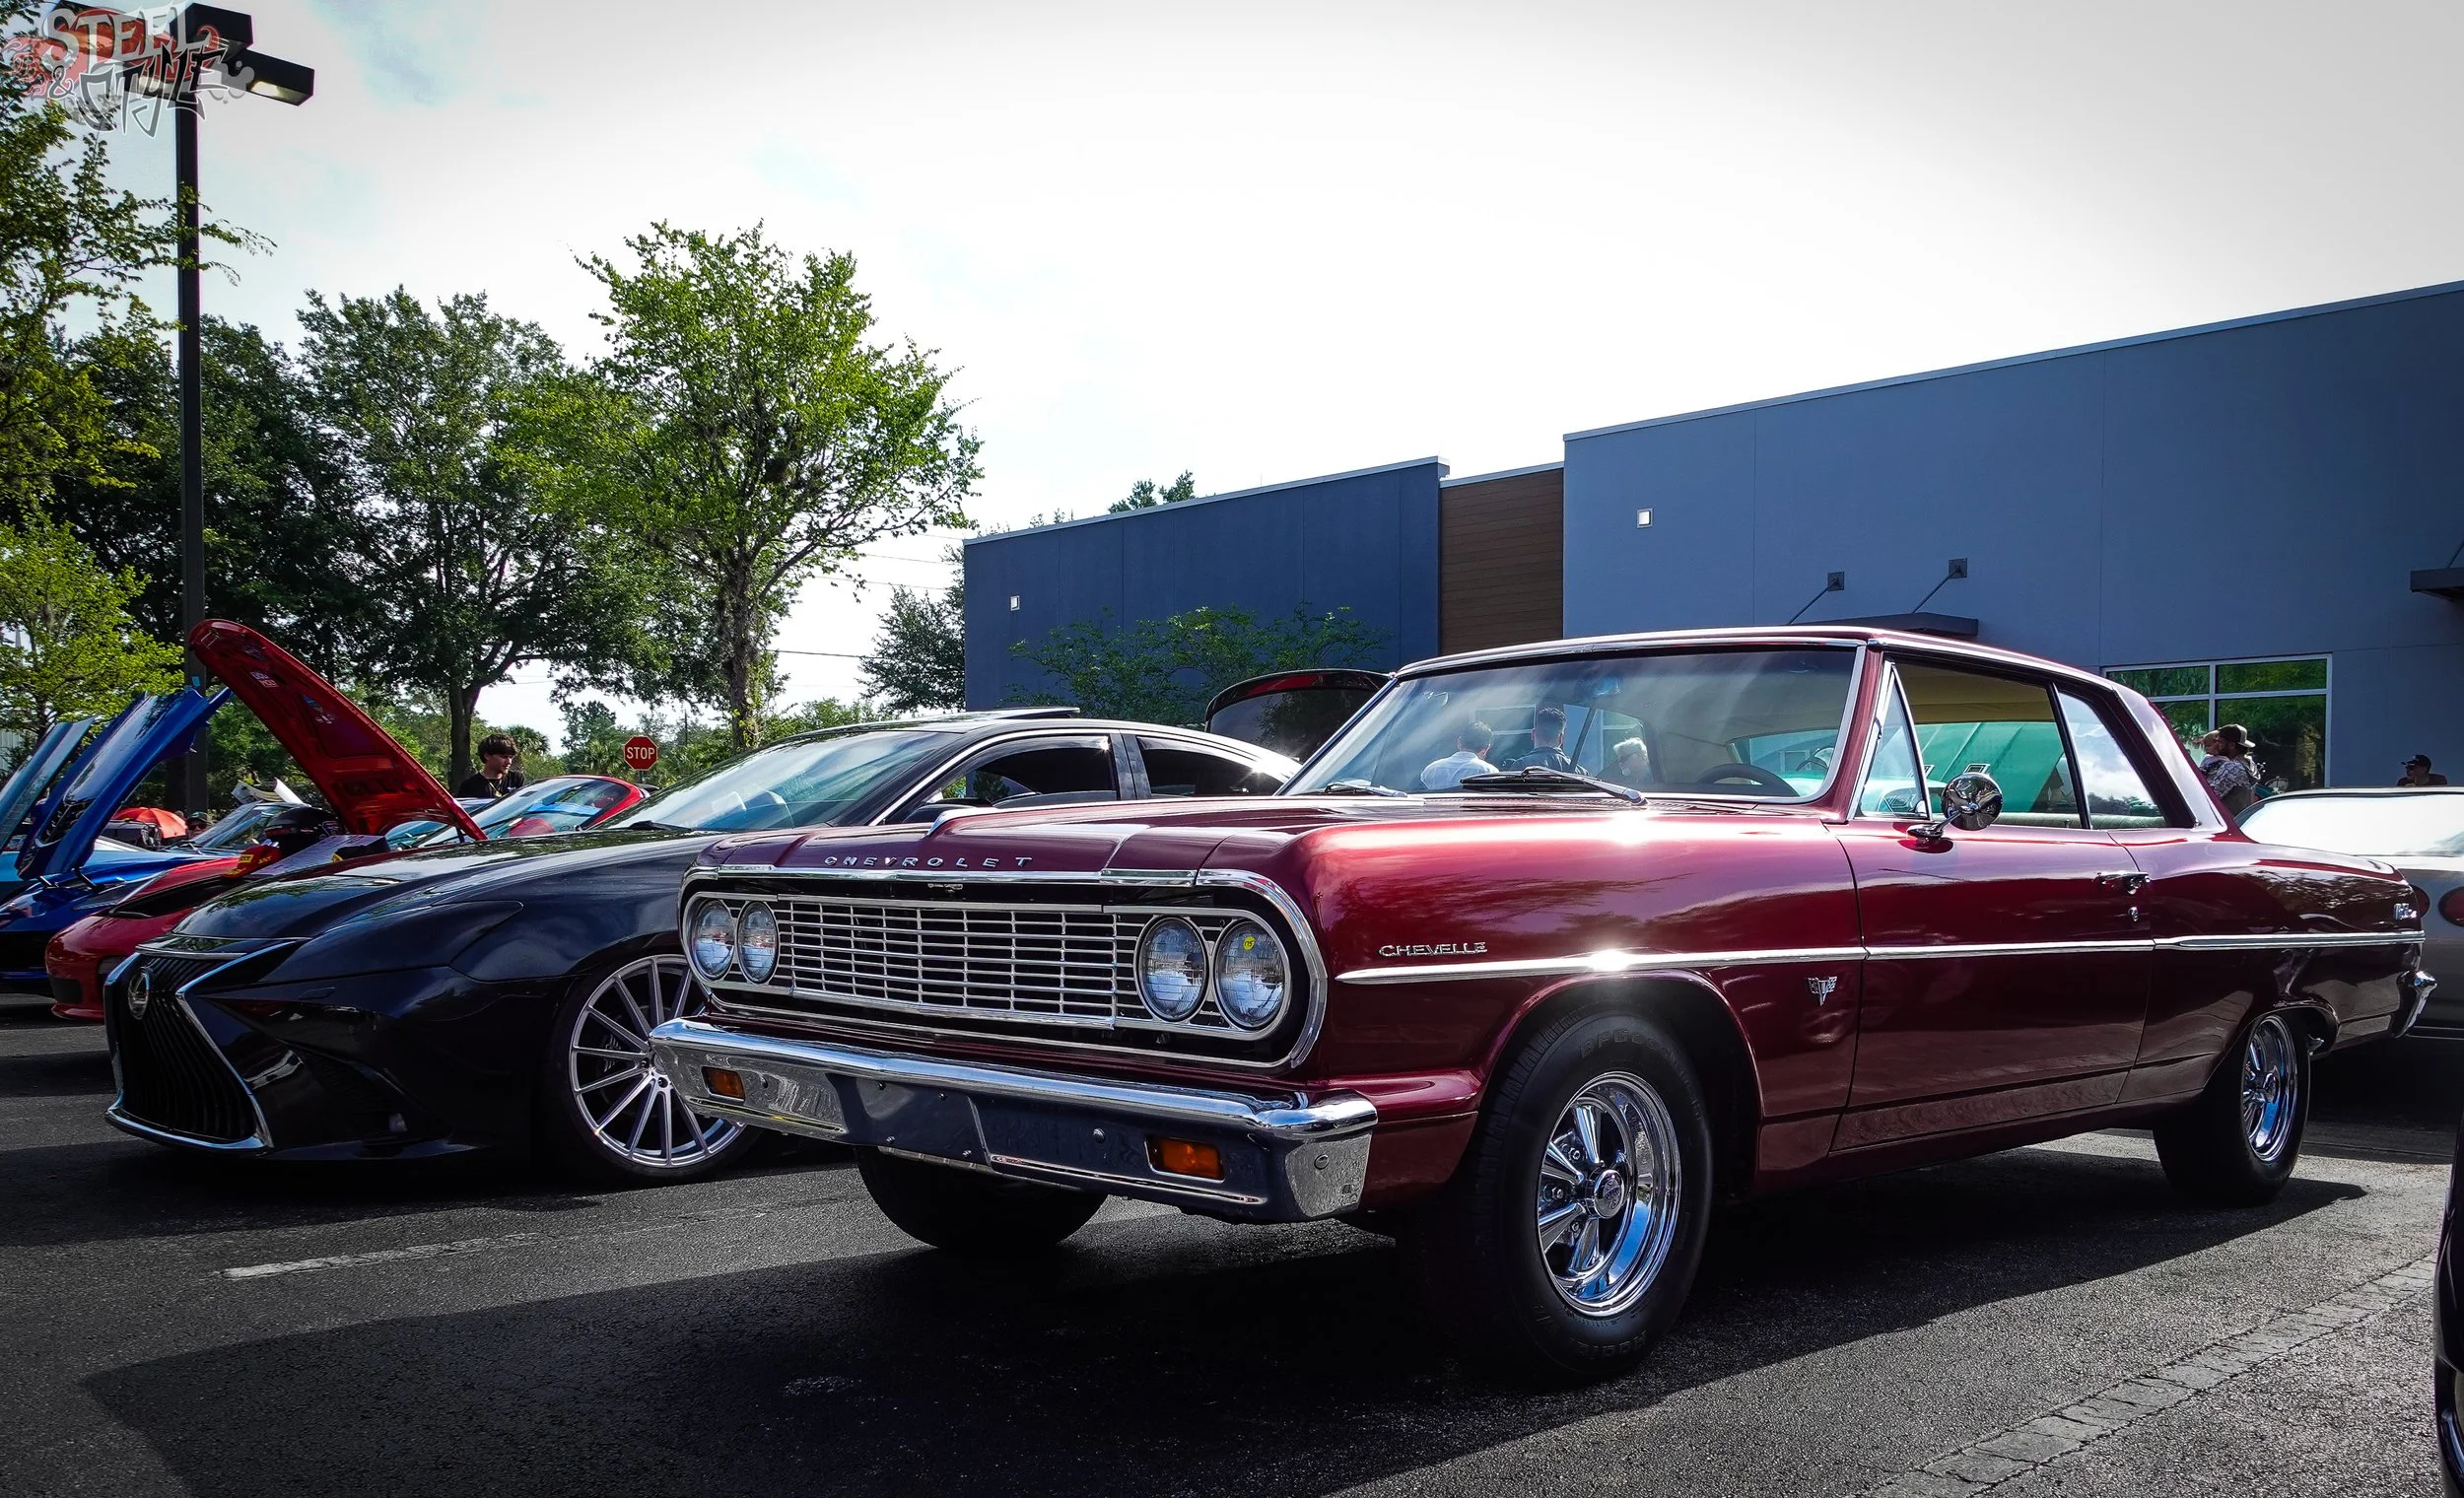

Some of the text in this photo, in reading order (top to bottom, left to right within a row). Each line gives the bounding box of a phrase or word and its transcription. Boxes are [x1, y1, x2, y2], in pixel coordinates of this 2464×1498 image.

[626, 746, 655, 760] STOP
[824, 855, 1033, 869] CHEVROLET
[1379, 941, 1488, 957] CHEVELLE
